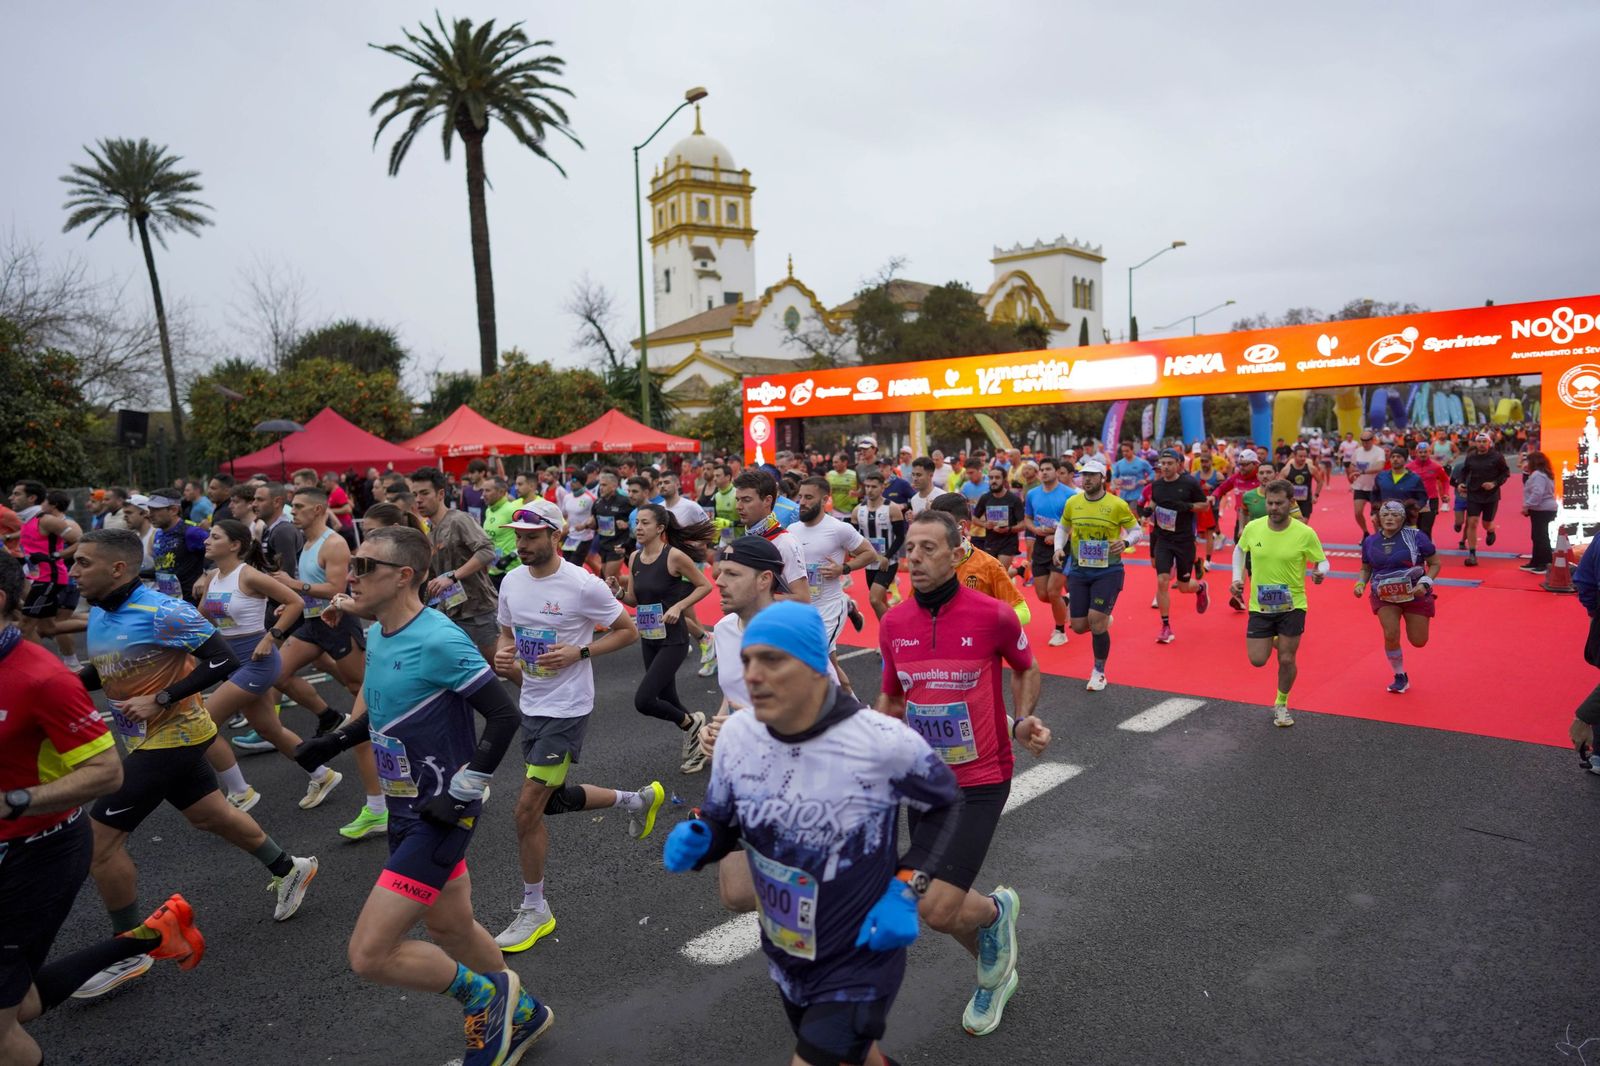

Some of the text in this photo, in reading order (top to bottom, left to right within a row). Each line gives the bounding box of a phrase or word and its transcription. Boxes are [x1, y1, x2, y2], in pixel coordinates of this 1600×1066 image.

[1422, 334, 1502, 352] Sprinter
[1163, 352, 1226, 376] HOKA
[1237, 361, 1286, 375] HYUNDAI
[1262, 591, 1283, 601] 2977
[639, 613, 656, 625] 2275
[519, 638, 546, 656] 3675
[912, 668, 949, 682] muebles
[914, 718, 955, 738] 3116
[735, 797, 841, 834] FURIOX
